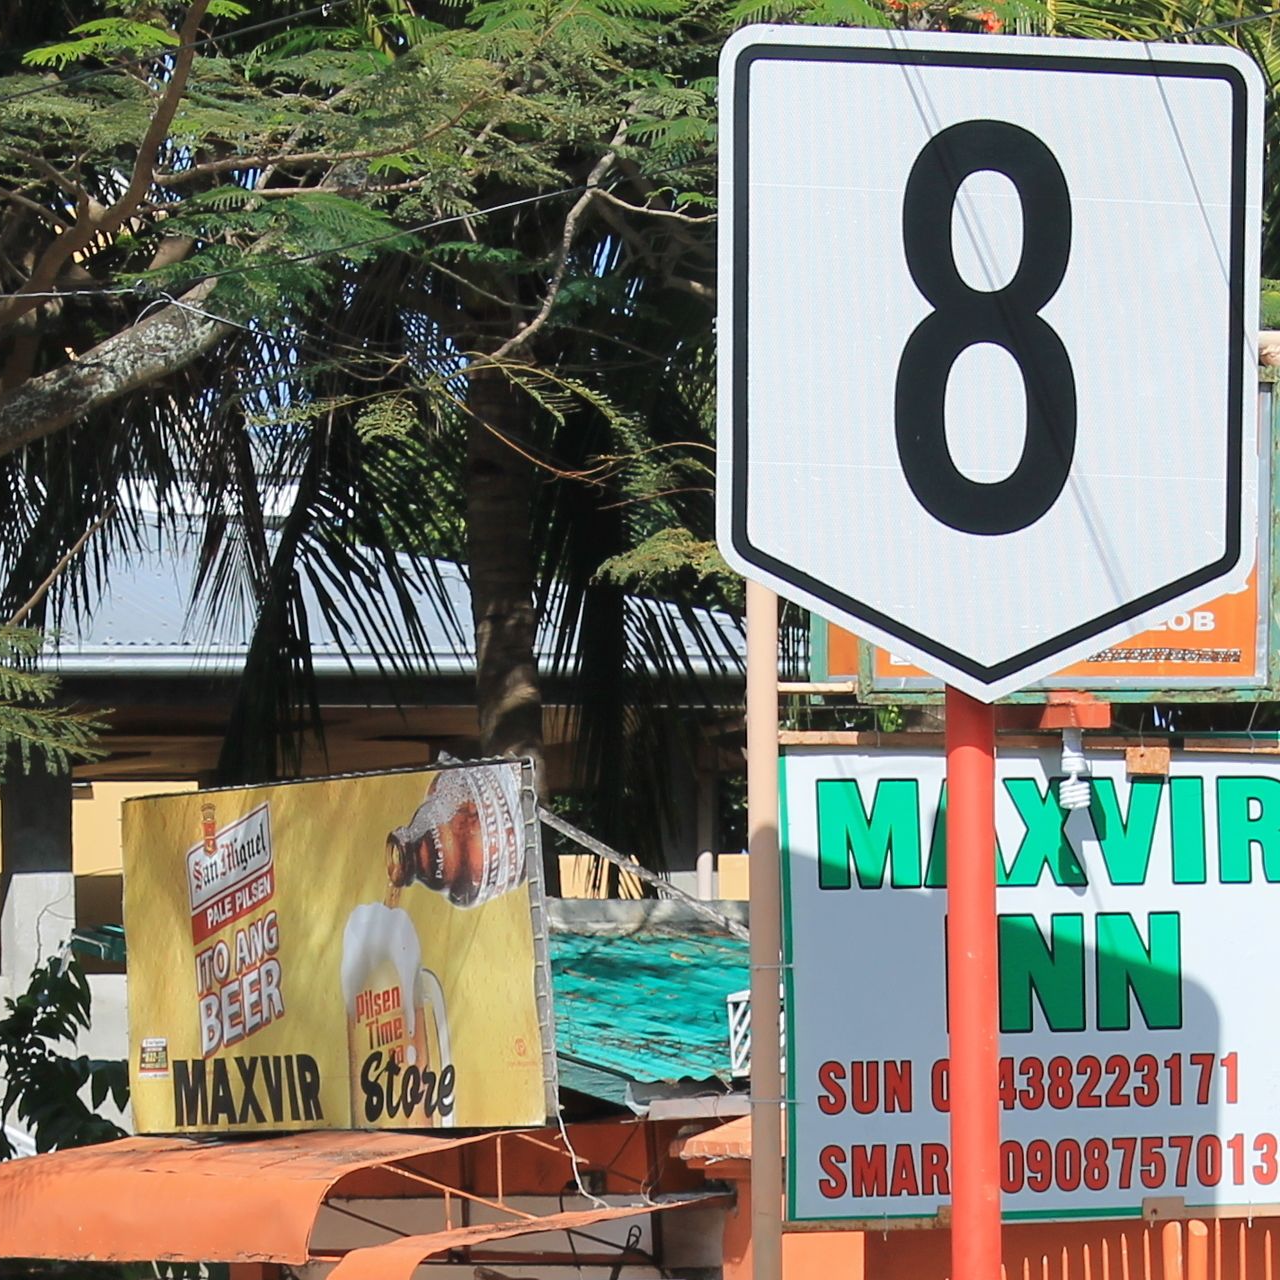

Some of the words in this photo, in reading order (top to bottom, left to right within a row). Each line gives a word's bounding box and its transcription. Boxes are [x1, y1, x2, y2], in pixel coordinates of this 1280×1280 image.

[895, 119, 1077, 536] 8
[1151, 611, 1216, 632] OB
[193, 860, 219, 893] San
[220, 819, 267, 876] Miguel
[206, 895, 233, 929] PALE
[235, 874, 271, 913] PILSEN
[195, 939, 230, 996] ITO
[235, 910, 279, 974] ANG
[945, 911, 1183, 1033] NN
[199, 958, 285, 1059] BEER
[355, 986, 401, 1023] Pilsen
[366, 1016, 402, 1050] Time
[173, 1054, 324, 1127] MAXVIR
[361, 1051, 455, 1122] Store
[818, 1060, 912, 1115] SUN
[931, 1052, 1238, 1112] 0438223171
[818, 1142, 951, 1199] SMAR
